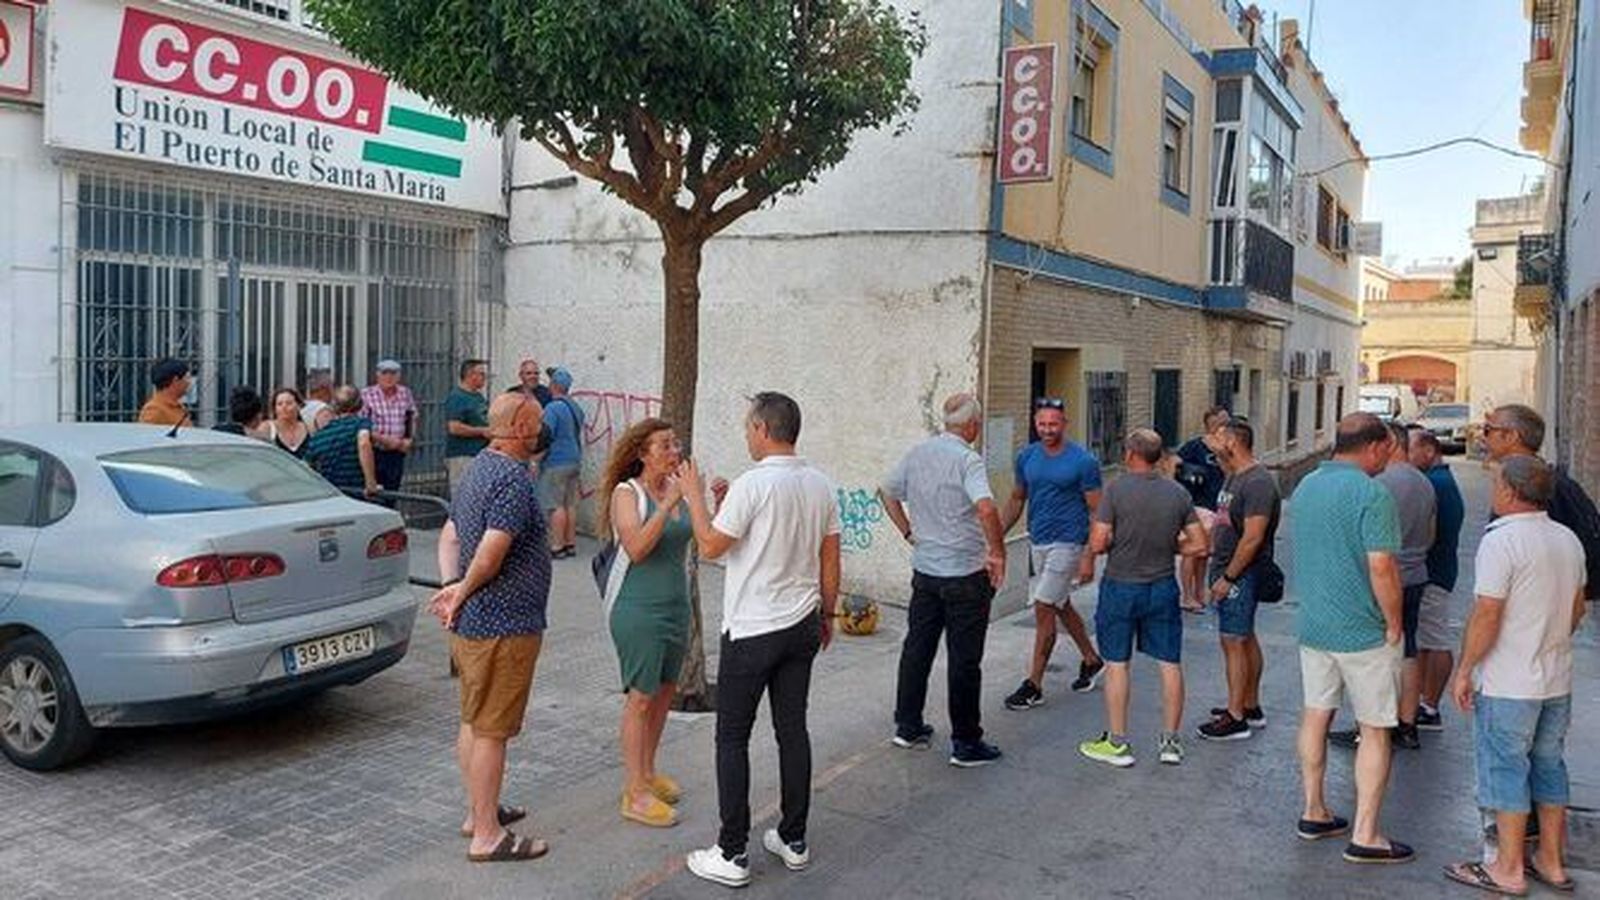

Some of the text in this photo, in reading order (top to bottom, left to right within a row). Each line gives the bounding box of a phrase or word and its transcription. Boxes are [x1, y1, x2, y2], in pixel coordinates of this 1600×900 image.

[139, 23, 370, 126] CC.OO.
[115, 86, 335, 153] Unión Local de
[115, 122, 447, 203] El Puerto de Santa María
[298, 630, 371, 666] 3913 CZV
